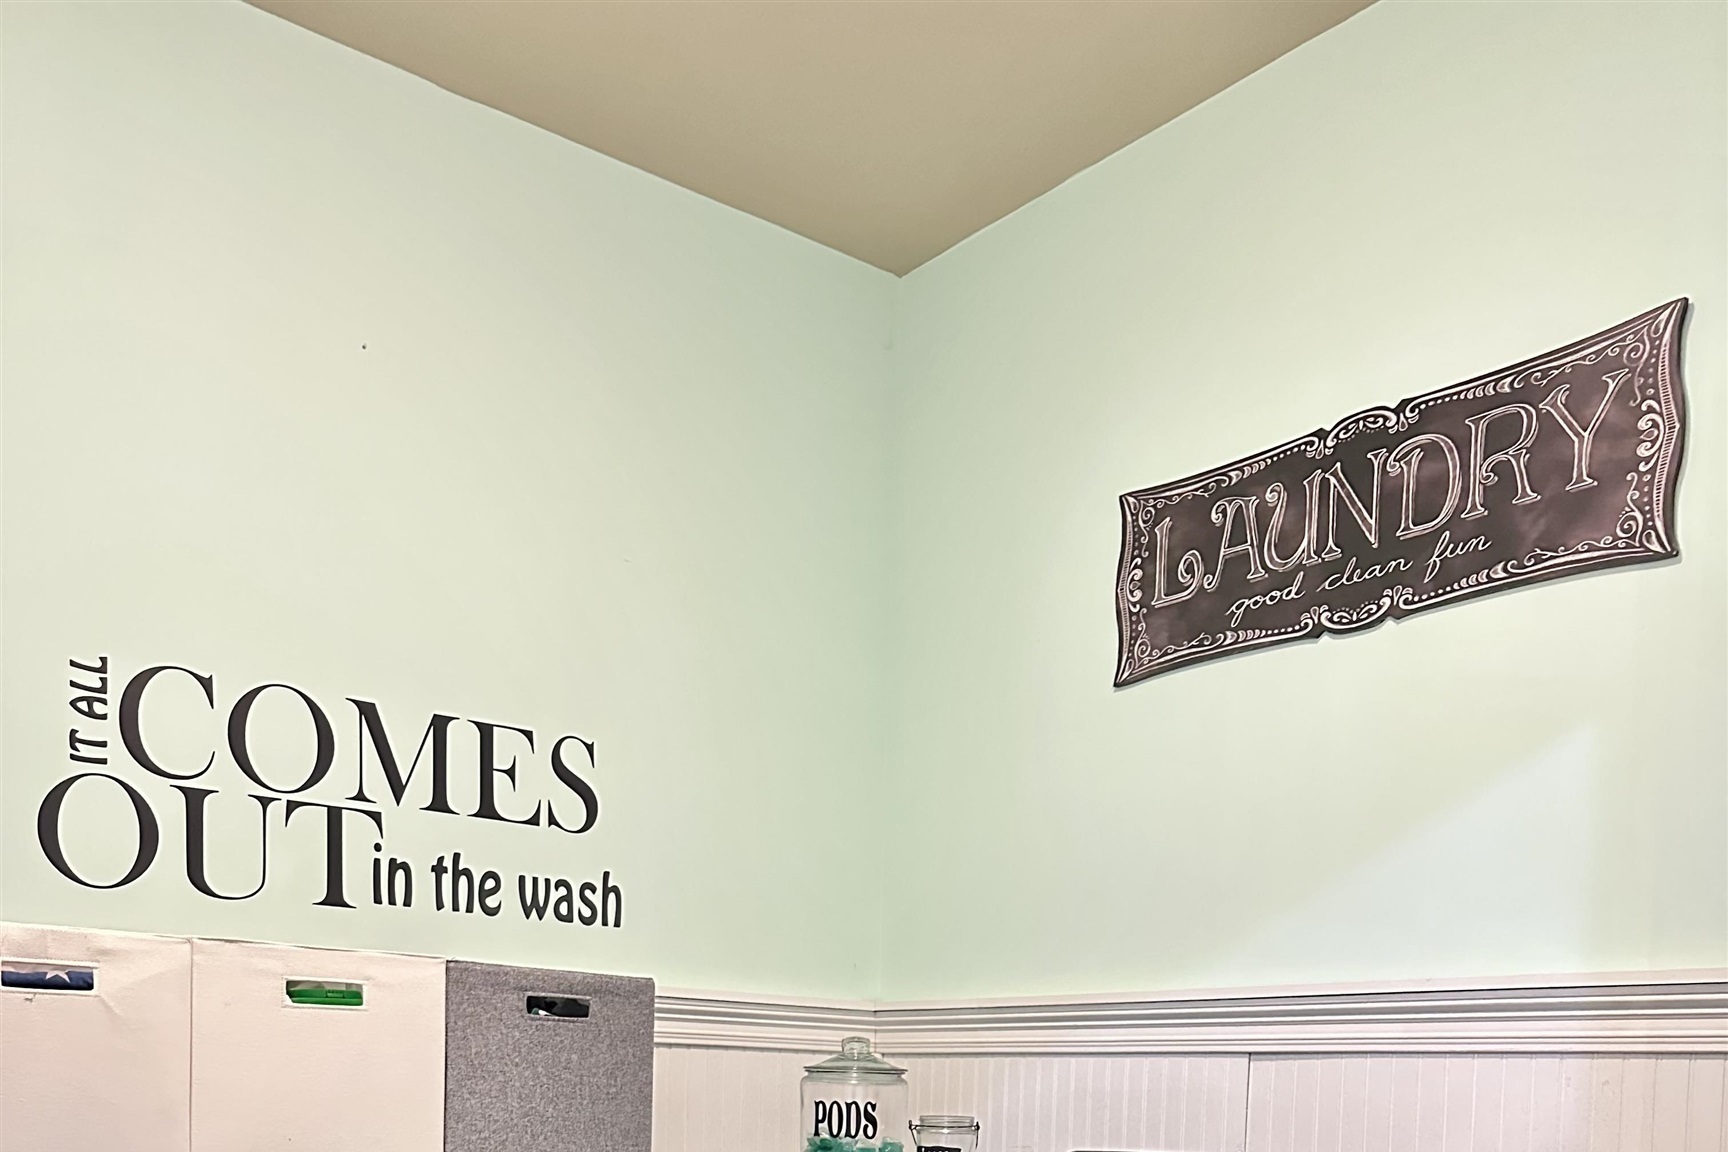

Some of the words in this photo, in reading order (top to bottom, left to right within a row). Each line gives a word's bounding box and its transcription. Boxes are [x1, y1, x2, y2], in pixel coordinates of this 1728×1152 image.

[1151, 369, 1631, 608] LAUNDRY
[1225, 575, 1304, 627] good
[1317, 555, 1413, 592] clean
[1424, 532, 1492, 583] fun
[69, 656, 108, 721] ALL
[69, 729, 108, 765] IT
[119, 666, 599, 834] COMES
[37, 773, 383, 909] OUT
[372, 843, 413, 908] in
[431, 853, 502, 917] the
[519, 871, 623, 928] wash
[813, 1100, 878, 1139] PODS
